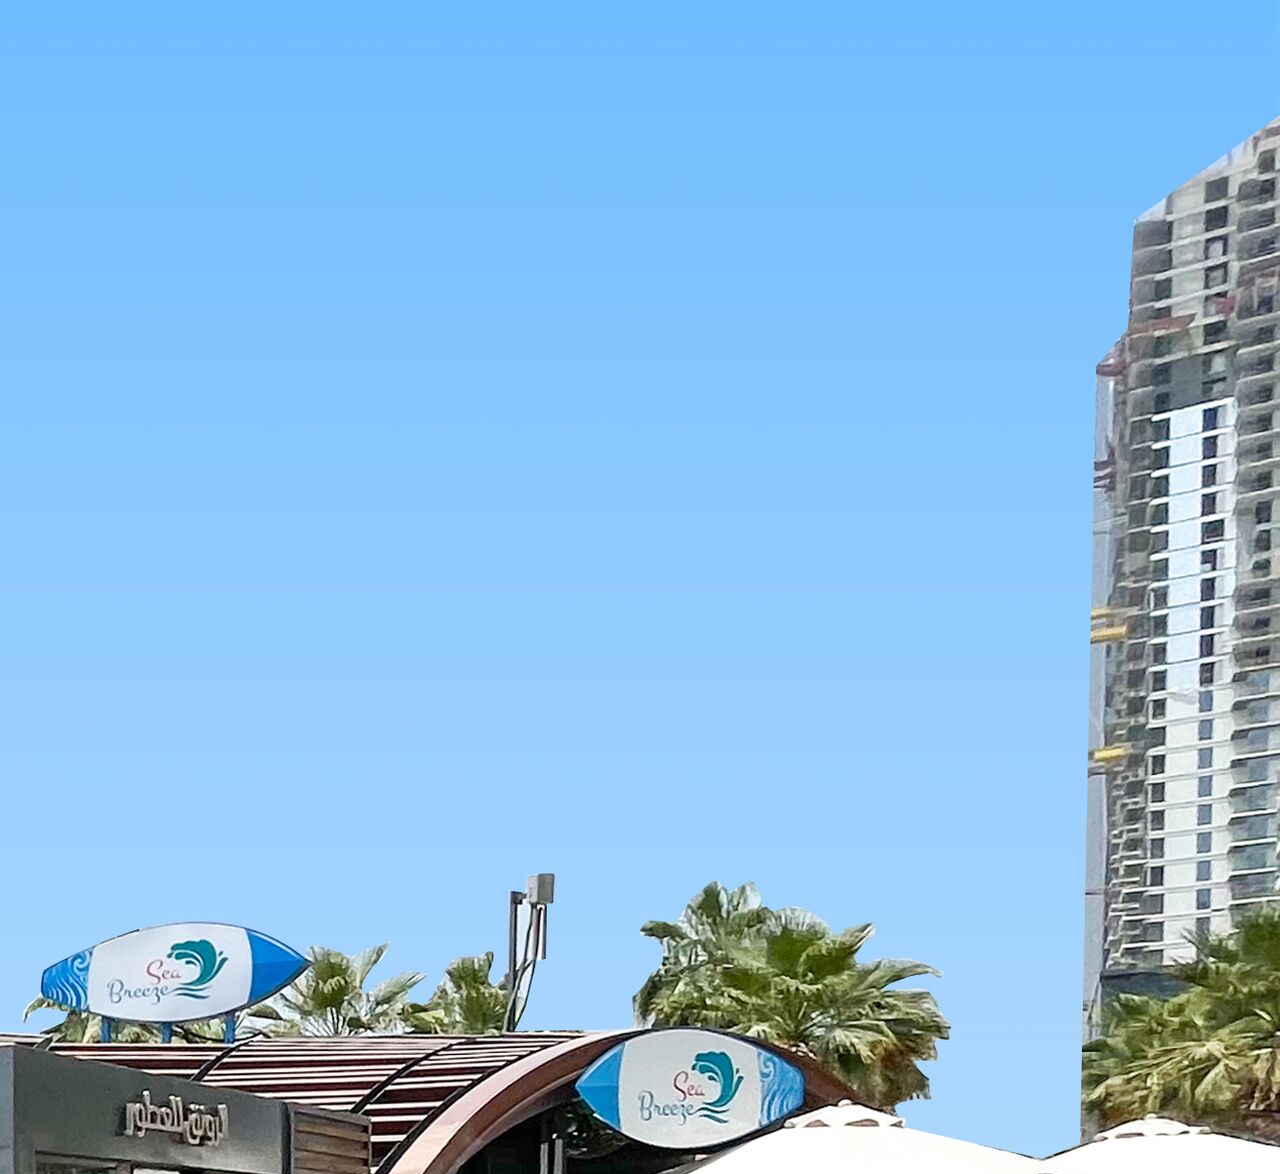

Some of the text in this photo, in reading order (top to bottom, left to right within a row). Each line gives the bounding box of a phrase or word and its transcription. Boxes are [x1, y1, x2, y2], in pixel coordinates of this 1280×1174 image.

[146, 959, 182, 985] Sea
[107, 978, 170, 1005] Breeze
[673, 1070, 706, 1102] Sea
[638, 1089, 697, 1126] Breeze
